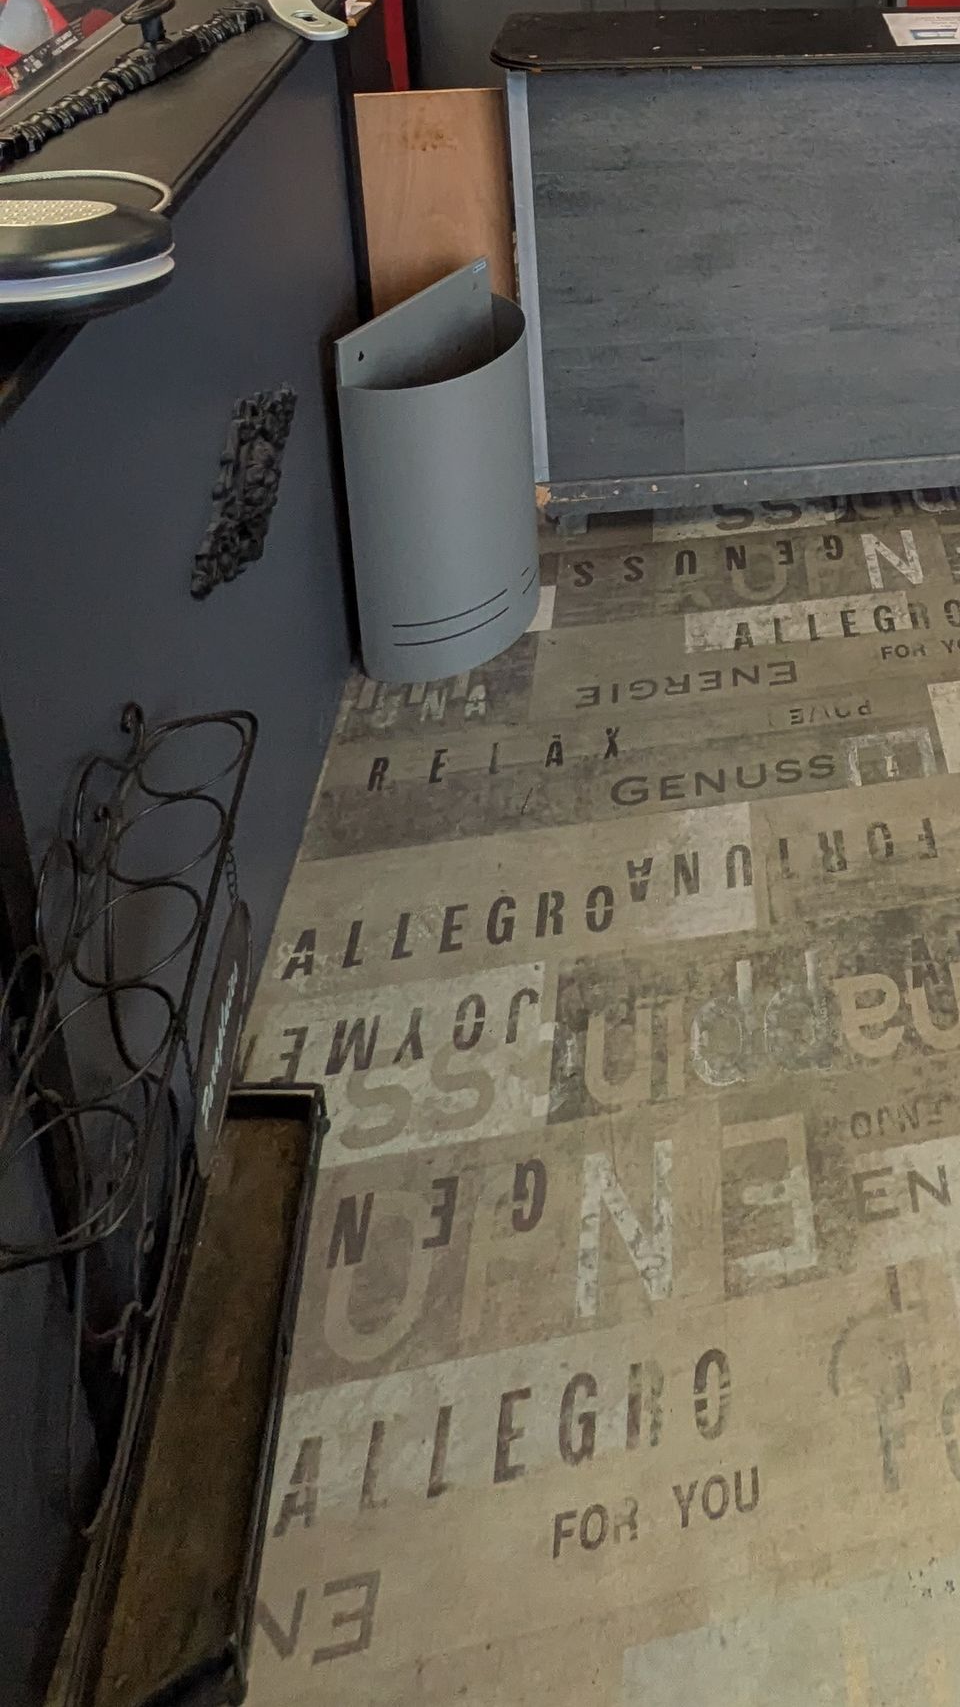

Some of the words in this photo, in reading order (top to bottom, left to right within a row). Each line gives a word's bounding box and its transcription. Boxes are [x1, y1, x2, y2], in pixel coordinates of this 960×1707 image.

[572, 533, 846, 588] GENUSS
[576, 661, 799, 708] ENERGIE
[609, 753, 838, 808] GENUSS
[281, 883, 615, 981] ALLEGRO
[325, 1157, 549, 1270] GEN
[272, 1347, 733, 1539] ALLEGRO
[551, 1496, 640, 1559] FOR
[671, 1465, 762, 1530] YOU
